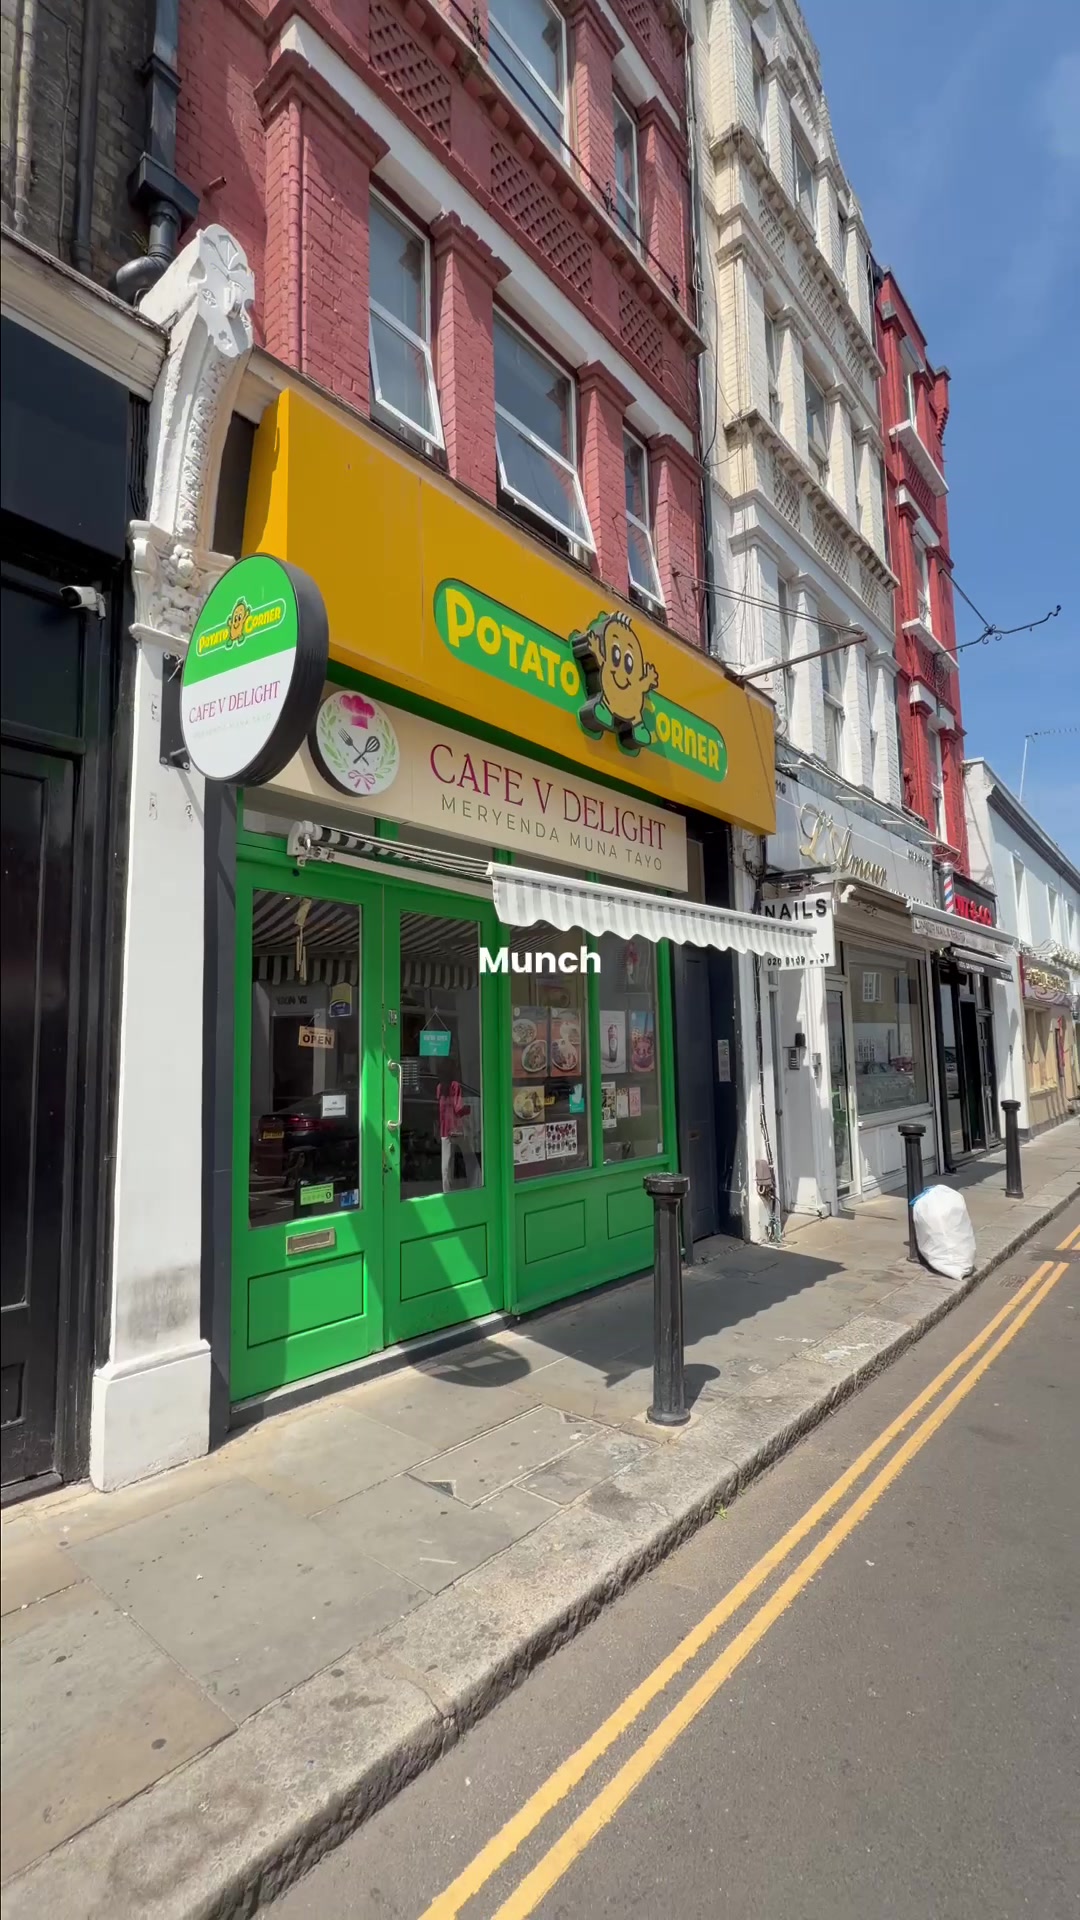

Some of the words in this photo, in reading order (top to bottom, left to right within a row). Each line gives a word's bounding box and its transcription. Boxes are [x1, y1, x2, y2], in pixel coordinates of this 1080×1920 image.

[199, 629, 229, 653] POTATO
[244, 607, 281, 633] CORNER
[445, 588, 580, 697] POTATO
[189, 701, 216, 724] CAFE
[218, 697, 226, 714] V
[228, 680, 280, 712] DELIGHT
[430, 743, 524, 807] CAFE
[532, 776, 554, 815] V
[562, 787, 667, 851] DELIGHT
[441, 793, 560, 843] MERYENDA
[570, 832, 618, 860] MUNA
[625, 848, 663, 872] TAYO
[765, 898, 827, 921] NAILS
[767, 957, 781, 968] 020
[303, 1034, 332, 1046] OPEN
